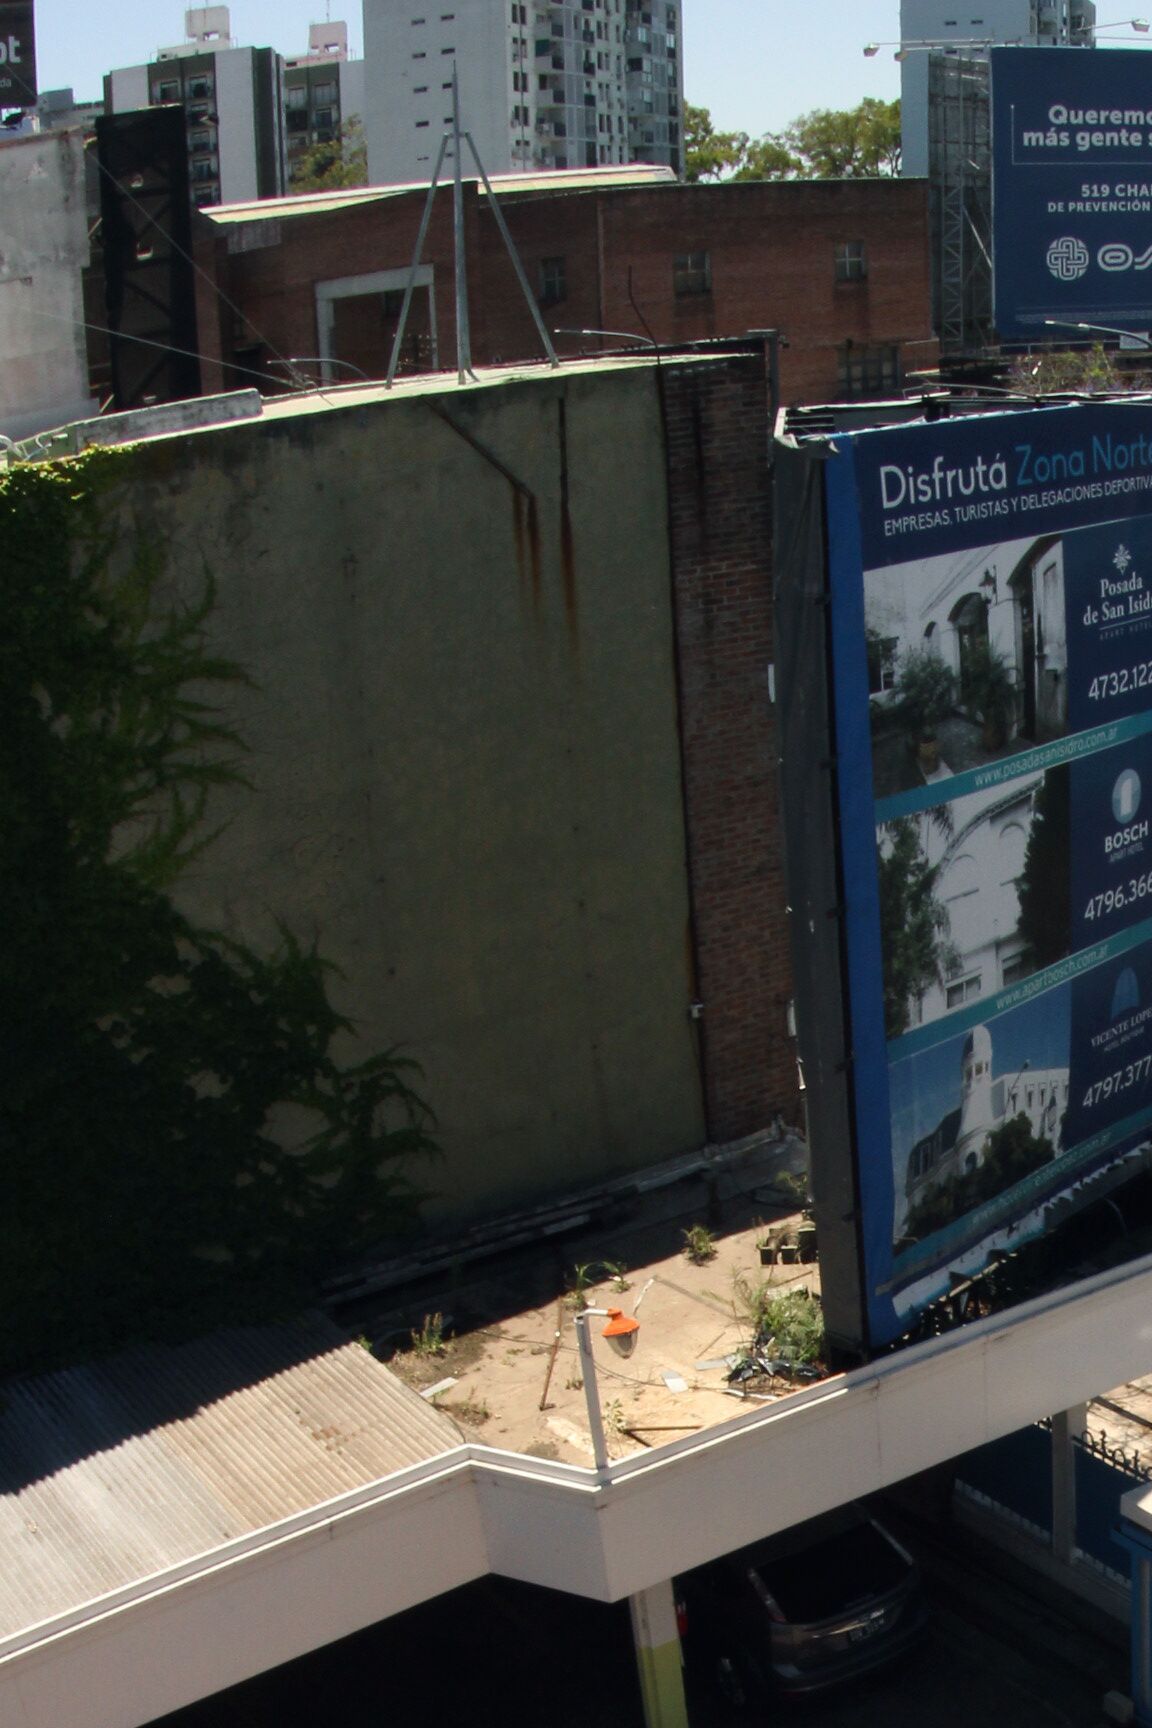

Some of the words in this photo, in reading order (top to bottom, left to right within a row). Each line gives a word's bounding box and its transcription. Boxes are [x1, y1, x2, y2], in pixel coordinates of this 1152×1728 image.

[1022, 127, 1070, 147] más
[1075, 128, 1143, 151] gente
[1081, 184, 1110, 198] 519
[1047, 202, 1064, 213] DE
[1068, 199, 1150, 212] PREVENCIÓN
[879, 453, 1007, 510] Disfrutá
[1014, 444, 1085, 487] Zona
[954, 496, 1010, 525] TURISTAS
[1011, 496, 1020, 513] Y
[1020, 481, 1103, 512] DELEGACIONES
[1100, 571, 1143, 598] Posada
[1083, 605, 1099, 626] de
[1102, 600, 1125, 622] San
[1104, 820, 1149, 853] BOSCH
